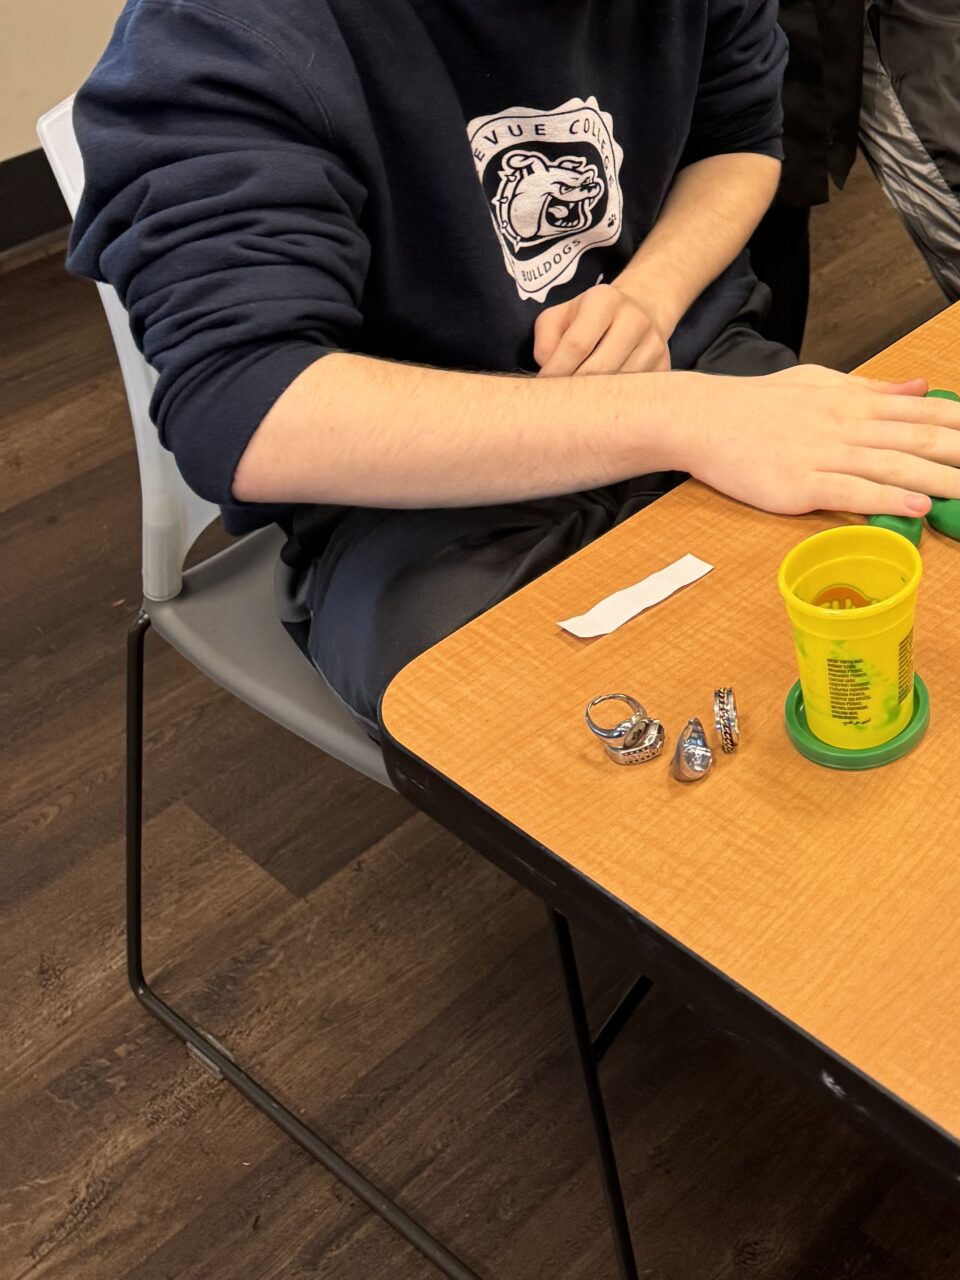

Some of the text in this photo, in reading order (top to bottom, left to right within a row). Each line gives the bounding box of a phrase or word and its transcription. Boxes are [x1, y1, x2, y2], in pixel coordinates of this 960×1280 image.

[473, 118, 614, 188] EVUE COLLEGE
[521, 238, 581, 282] BULLDOGS
